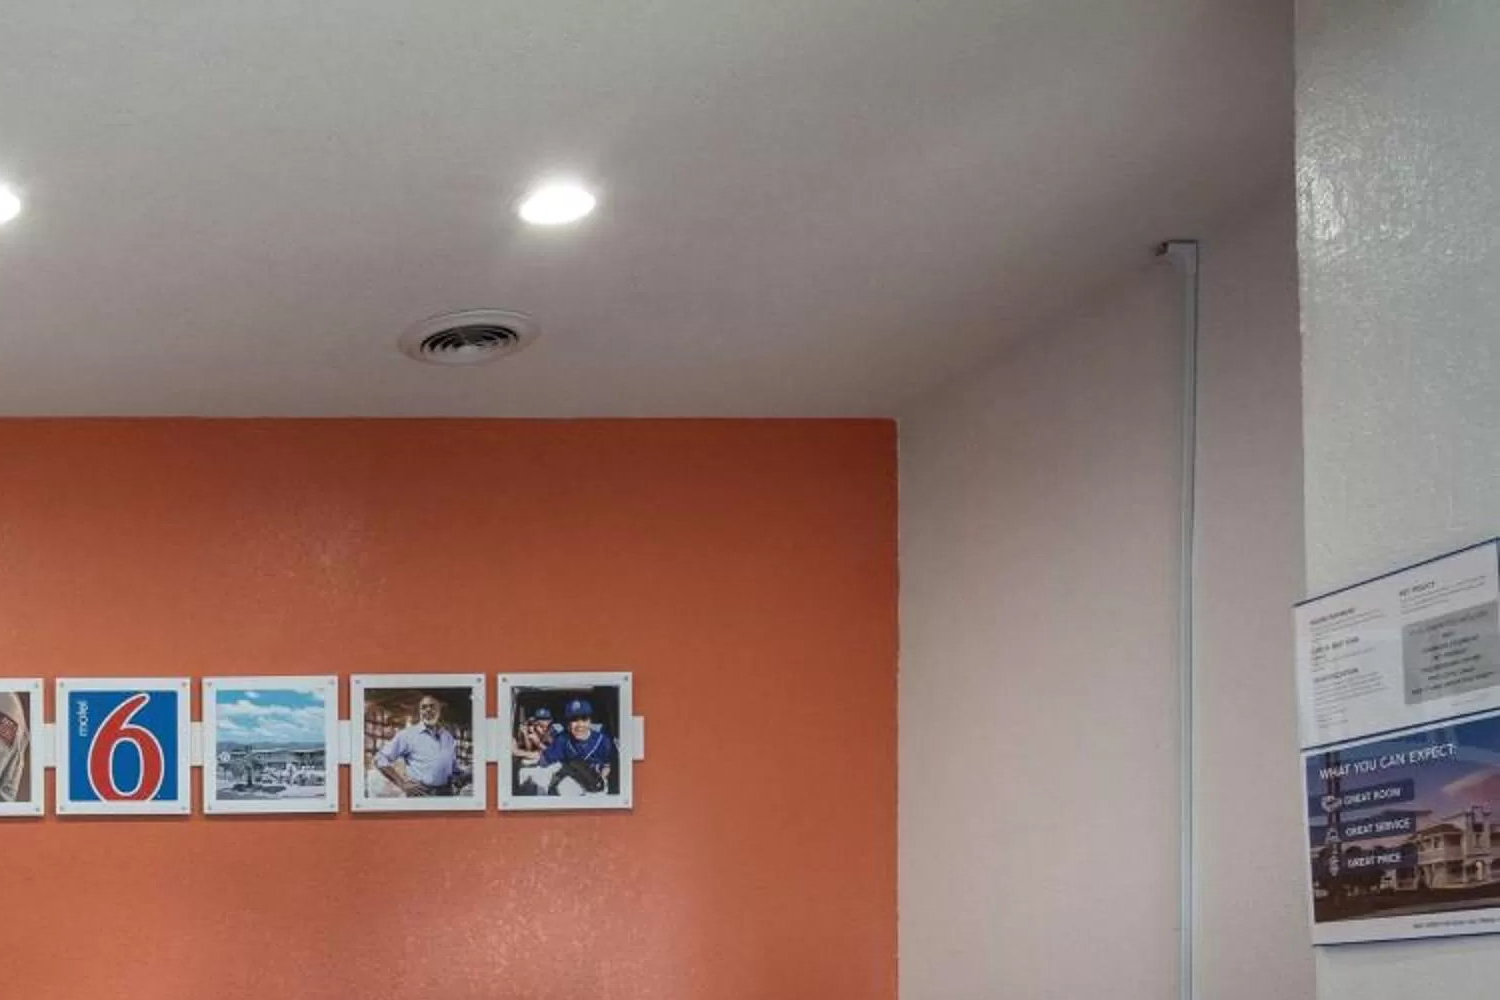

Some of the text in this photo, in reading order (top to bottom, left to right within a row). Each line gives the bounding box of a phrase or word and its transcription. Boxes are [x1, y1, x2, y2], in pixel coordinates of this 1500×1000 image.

[87, 693, 165, 802] 6
[1319, 764, 1351, 781] WHAT
[1353, 759, 1377, 774] YOU
[1380, 754, 1406, 769] CAN
[1344, 788, 1401, 805] GREAT ROOM
[1345, 822, 1373, 837] GREAT
[1347, 855, 1375, 868] GREAT
